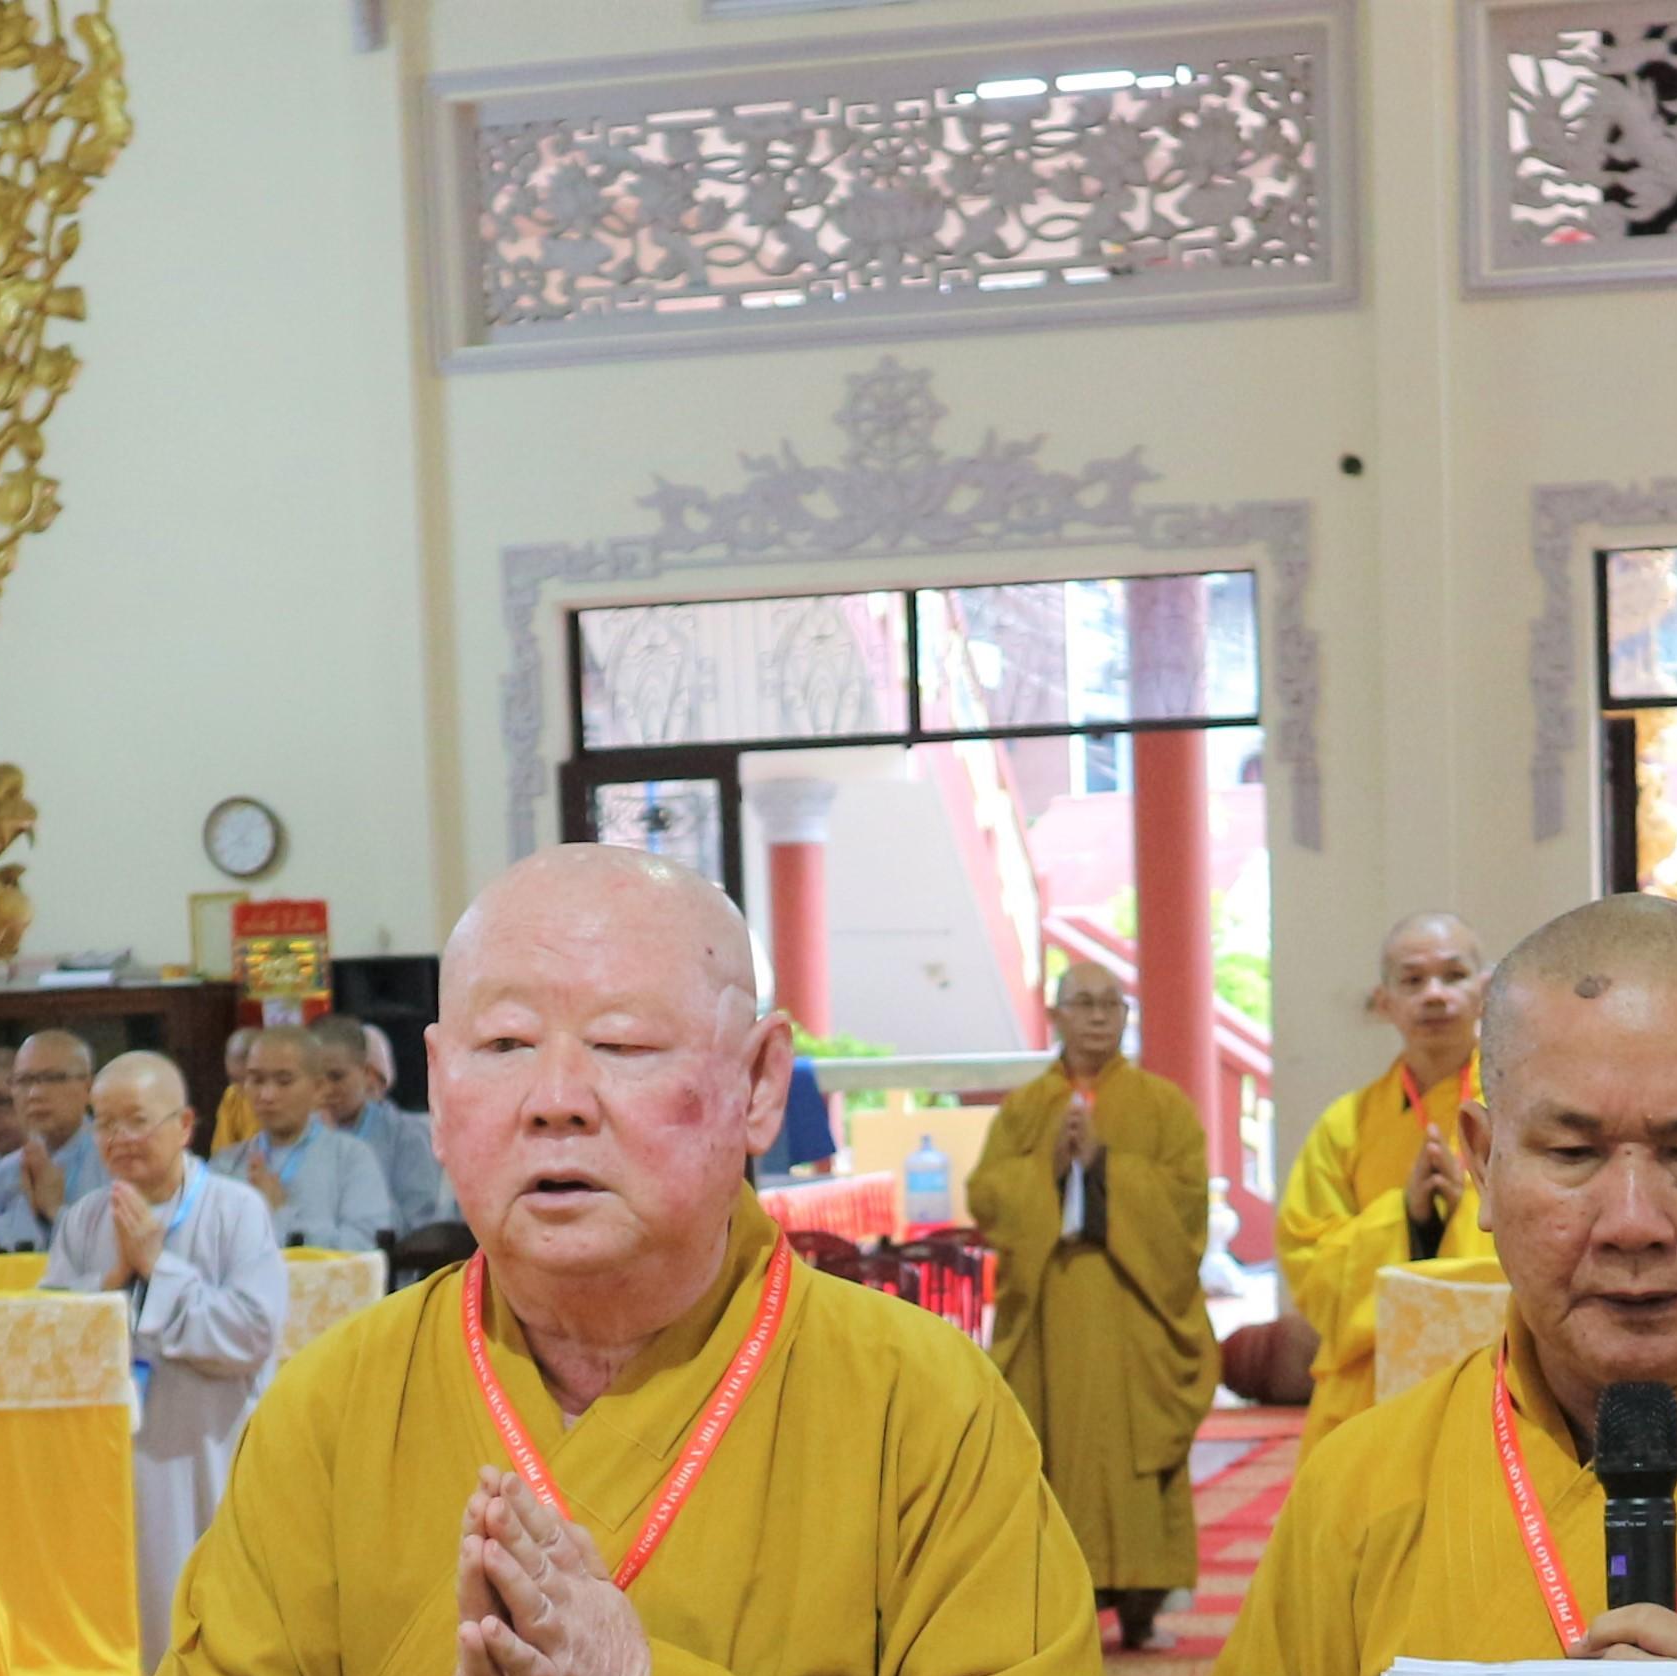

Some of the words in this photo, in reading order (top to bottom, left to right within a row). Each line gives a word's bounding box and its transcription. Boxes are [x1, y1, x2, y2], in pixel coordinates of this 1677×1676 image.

[1510, 1479, 1531, 1512] NAM
[1521, 1512, 1544, 1545] VIỆT
[1532, 1544, 1559, 1584] GIÁO
[1548, 1583, 1575, 1623] PHẬT
